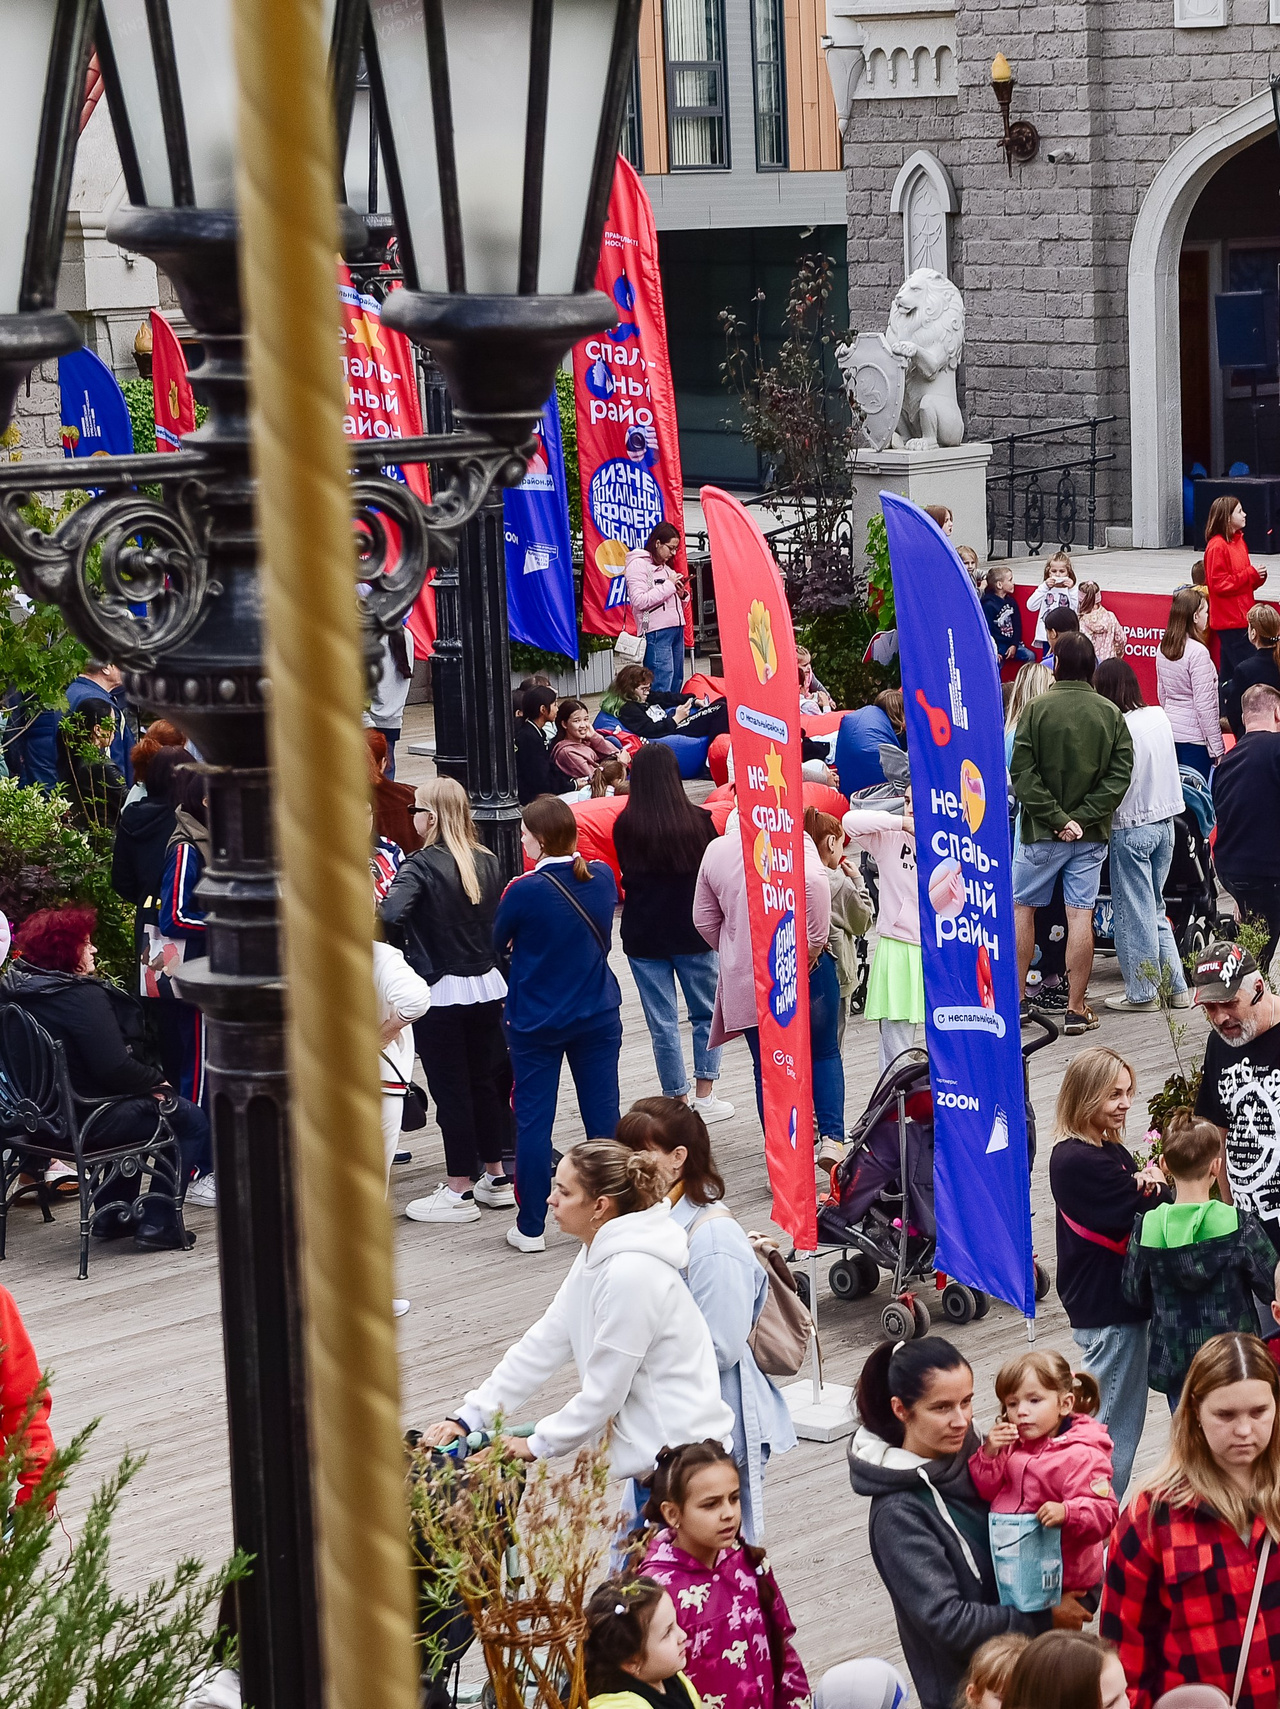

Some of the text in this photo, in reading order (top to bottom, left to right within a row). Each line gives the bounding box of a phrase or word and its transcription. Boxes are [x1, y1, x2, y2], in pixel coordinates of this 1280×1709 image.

[589, 399, 654, 426] райо
[341, 411, 403, 440] айон
[1122, 625, 1167, 641] РАВИТЕ
[1123, 643, 1162, 658] ОСКВ
[902, 862, 914, 871] BY
[1197, 962, 1220, 974] MOTUL
[936, 1091, 980, 1112] ZOON
[1247, 1152, 1260, 1160] face
